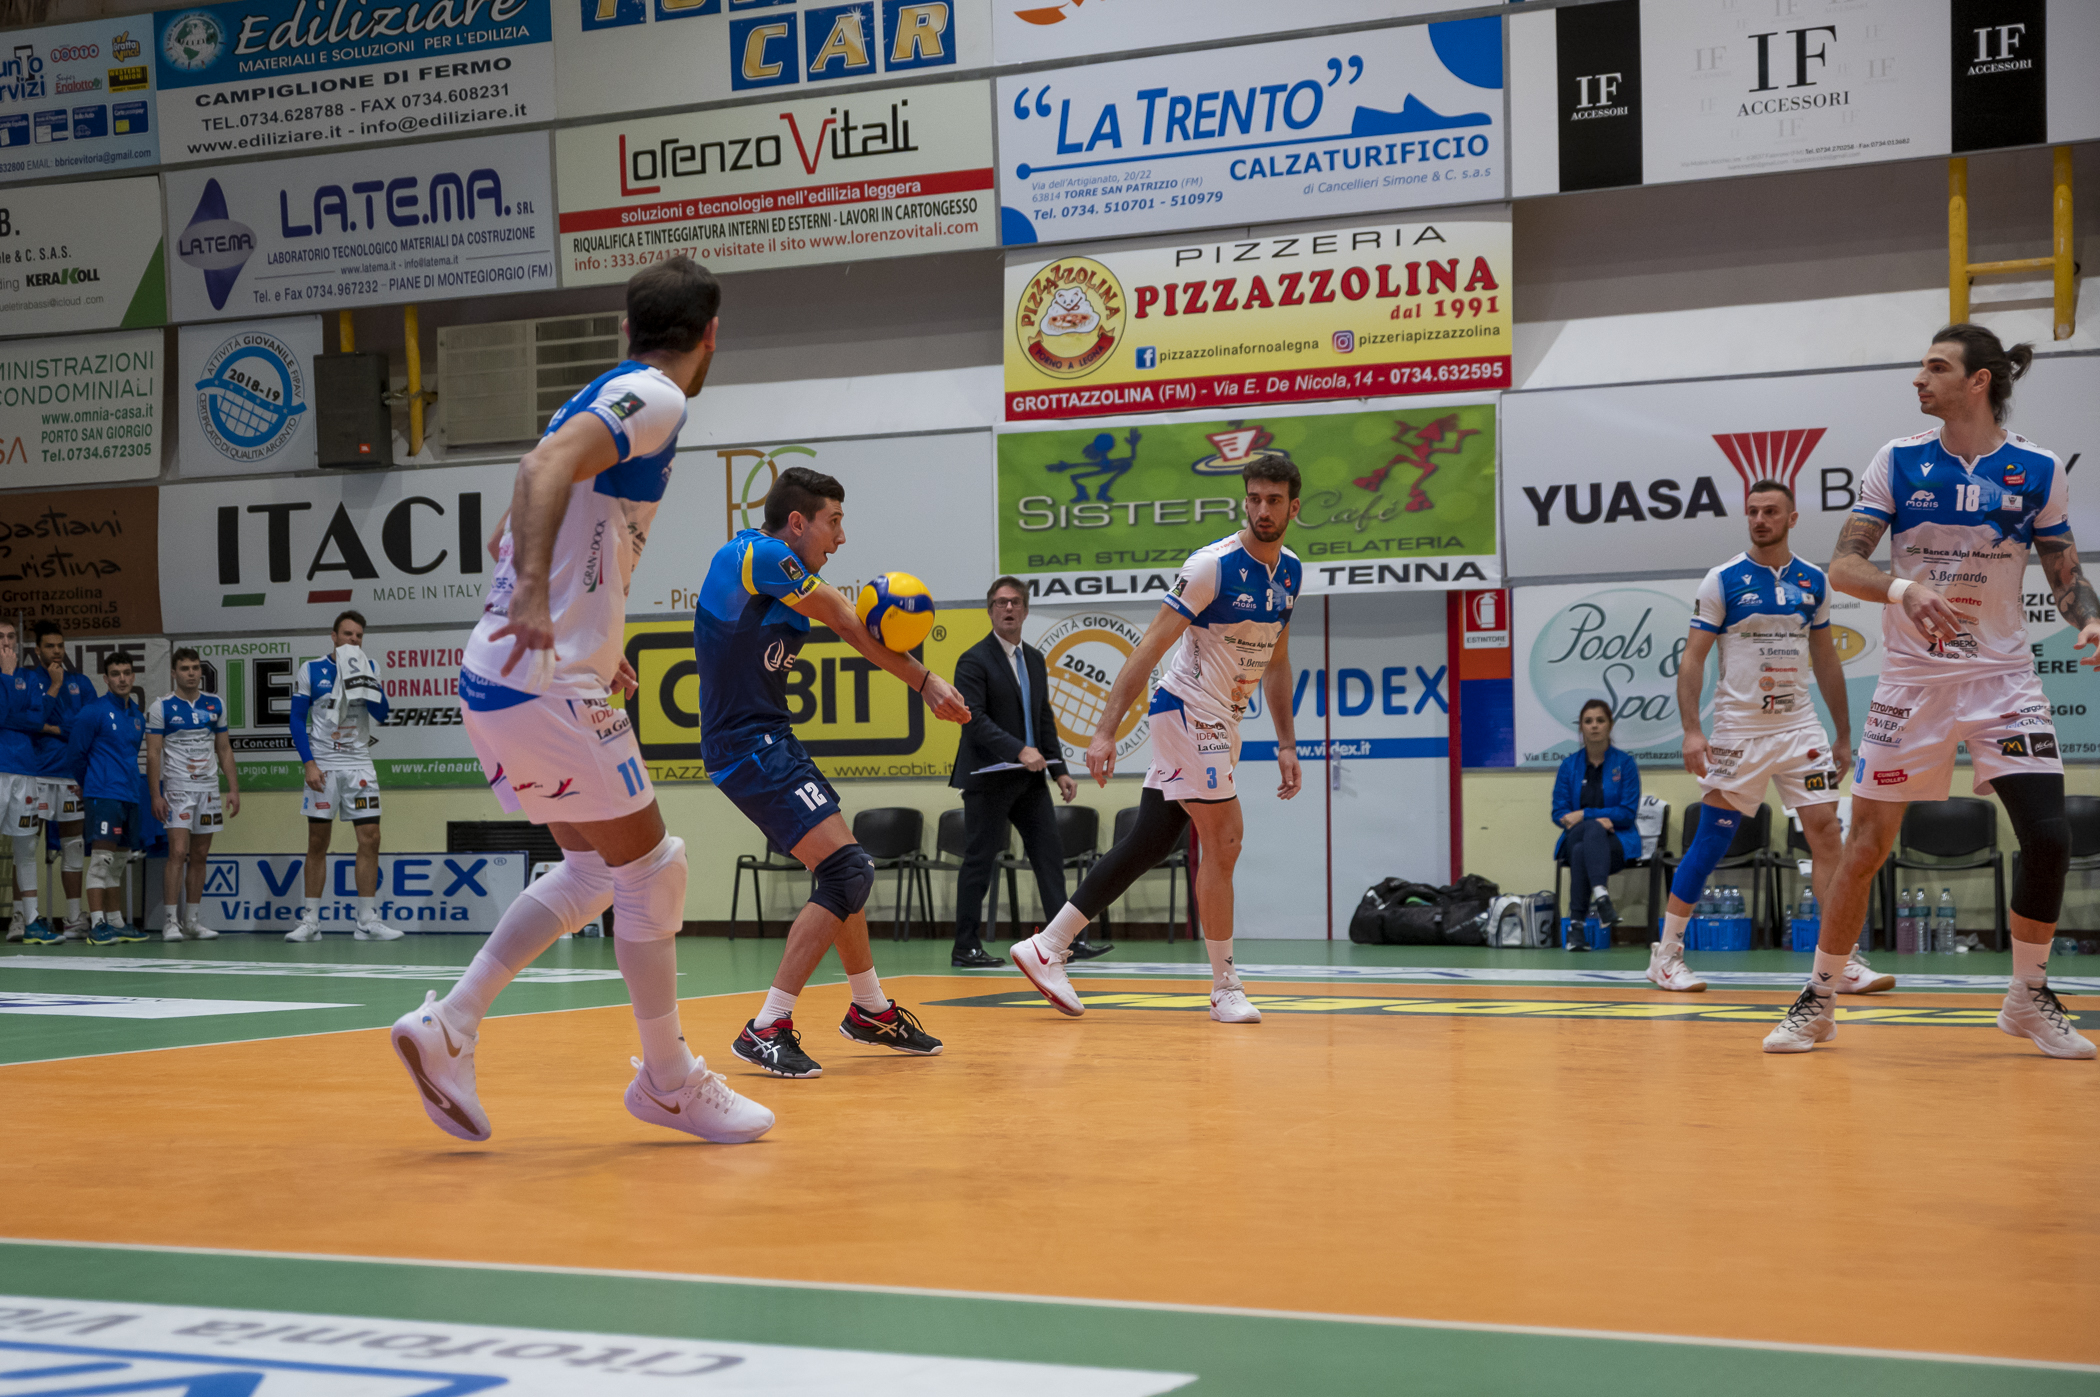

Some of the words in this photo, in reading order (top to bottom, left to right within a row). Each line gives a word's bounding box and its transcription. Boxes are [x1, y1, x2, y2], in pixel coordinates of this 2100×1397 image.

[239, 53, 315, 73] MATERIALI
[319, 51, 328, 63] E
[332, 40, 414, 62] SOLUZIONI
[424, 37, 452, 50] PER
[456, 26, 530, 47] L'EDILIZIA
[742, 2, 950, 80] CAR
[1973, 22, 2026, 63] IF
[1748, 25, 1837, 92] IF
[1967, 58, 2033, 77] ACCESSORI
[196, 74, 374, 107] CAMPIGLIONE
[384, 71, 409, 85] DI
[419, 57, 512, 80] FERMO
[1576, 71, 1622, 109] IF
[202, 103, 344, 132] TEL.0734.628788
[361, 97, 397, 113] FAX
[402, 82, 510, 108] 0734.608231
[1571, 105, 1628, 121] ACCESSORI
[1737, 91, 1850, 117] ACCESSORI
[187, 125, 342, 154] www.ediliziare.it
[361, 104, 528, 134] info@ediliziare.it
[619, 133, 781, 197] Lorenzo
[779, 99, 918, 176] Vitali
[1229, 134, 1490, 182] CALZATURIFICIO
[1031, 192, 1061, 204] 63814
[1064, 188, 1098, 200] TORRE
[1101, 185, 1122, 196] SAN
[1126, 179, 1178, 193] PATRIZIO
[1181, 177, 1204, 188] (FM)
[1032, 180, 1046, 191] Via
[1124, 169, 1152, 182] 20/22
[1303, 183, 1314, 194] di
[1317, 176, 1380, 193] Cancellieri
[1383, 172, 1429, 188] Simone
[1432, 171, 1443, 182] &
[1445, 169, 1457, 181] C.
[516, 200, 535, 216] SRL
[621, 204, 683, 224] soluzioni
[686, 204, 695, 215] e
[699, 193, 774, 218] tecnologie
[777, 186, 860, 206] nell'edilizia
[864, 178, 921, 201] leggera
[1033, 207, 1057, 220] Tel.
[1061, 203, 1099, 218] 0734.
[1103, 198, 1155, 213] 510701
[1171, 190, 1224, 206] 510979
[573, 235, 635, 253] RIQUALIFICA
[637, 233, 645, 247] E
[645, 224, 726, 246] TINTEGGIATURA
[729, 219, 770, 235] INTERNI
[773, 217, 786, 231] ED
[789, 213, 831, 230] ESTERNI
[839, 208, 880, 225] LAVORI
[882, 207, 893, 221] IN
[895, 197, 978, 219] CARTONGESSO
[40, 246, 71, 260] S.A.S.
[267, 247, 331, 265] LABORATORIO
[332, 240, 397, 259] TECNOLOGICO
[400, 234, 449, 253] MATERIALI
[451, 232, 465, 247] DA
[467, 226, 536, 245] COSTRUZIONE
[574, 256, 602, 271] info
[702, 246, 711, 259] o
[715, 239, 765, 258] visitate
[768, 238, 777, 251] il
[780, 236, 806, 251] sito
[810, 219, 979, 248] www.lorenzovitali.com
[1175, 225, 1447, 268] PIZZERIA
[26, 268, 100, 287] KERAKOLL
[340, 260, 396, 275] www.latema.it
[404, 254, 459, 270] info@latema.it
[253, 288, 272, 304] Tel.
[274, 290, 282, 302] e
[284, 287, 303, 302] Fax
[306, 280, 379, 299] 0734.967232
[388, 275, 421, 291] PIANE
[423, 274, 435, 288] DI
[437, 265, 526, 287] MONTEGIORGIO
[527, 262, 553, 281] (FM)
[1021, 264, 1121, 327] PIZZAZZOLINA
[1134, 256, 1500, 319] PIZZAZZOLINA
[1390, 303, 1422, 320] dal
[1433, 295, 1500, 319] 1991
[1159, 338, 1319, 364] pizzazzolinafornoalegna
[1358, 324, 1501, 348] pizzeriapizzazzolina
[0, 350, 153, 382] INISTRAZIONI
[243, 335, 293, 369] GIOVANILE
[290, 369, 303, 399] FIPAV
[0, 377, 153, 407] ONDOMINIALI
[229, 368, 281, 402] 2018-19
[1012, 386, 1155, 413] GROTTAZZOLINA
[1159, 381, 1197, 403] (FM)
[1212, 379, 1239, 398] Via
[1243, 378, 1261, 395] E.
[1265, 375, 1290, 392] De
[1389, 361, 1504, 385] 0734.632595
[41, 402, 153, 425] www.omnia-casa.it
[41, 428, 78, 444] PORTO
[81, 424, 104, 441] SAN
[106, 422, 153, 439] GIORGIO
[41, 442, 152, 463] Tel.0734.672305
[1522, 476, 1728, 527] YUASA
[1905, 500, 1939, 509] MORIS
[1956, 484, 1980, 512] 18
[1028, 553, 1081, 568] BAR
[1308, 535, 1465, 556] GELATERIA
[1923, 548, 1950, 557] Banca
[1319, 561, 1488, 586] TENNA
[2, 587, 103, 602] Grottazzolina
[373, 588, 415, 602] MADE
[422, 587, 437, 600] IN
[444, 583, 483, 599] ITALY
[1233, 601, 1257, 610] MORIS
[1266, 588, 1273, 611] 3
[1466, 635, 1507, 644] ESTINTORE
[1548, 603, 1653, 664] Pools
[386, 648, 463, 668] SERVIZIO
[617, 756, 645, 798] 11
[834, 763, 954, 777] www.cobit.it
[1206, 767, 1218, 789] 3
[793, 781, 828, 812] 12
